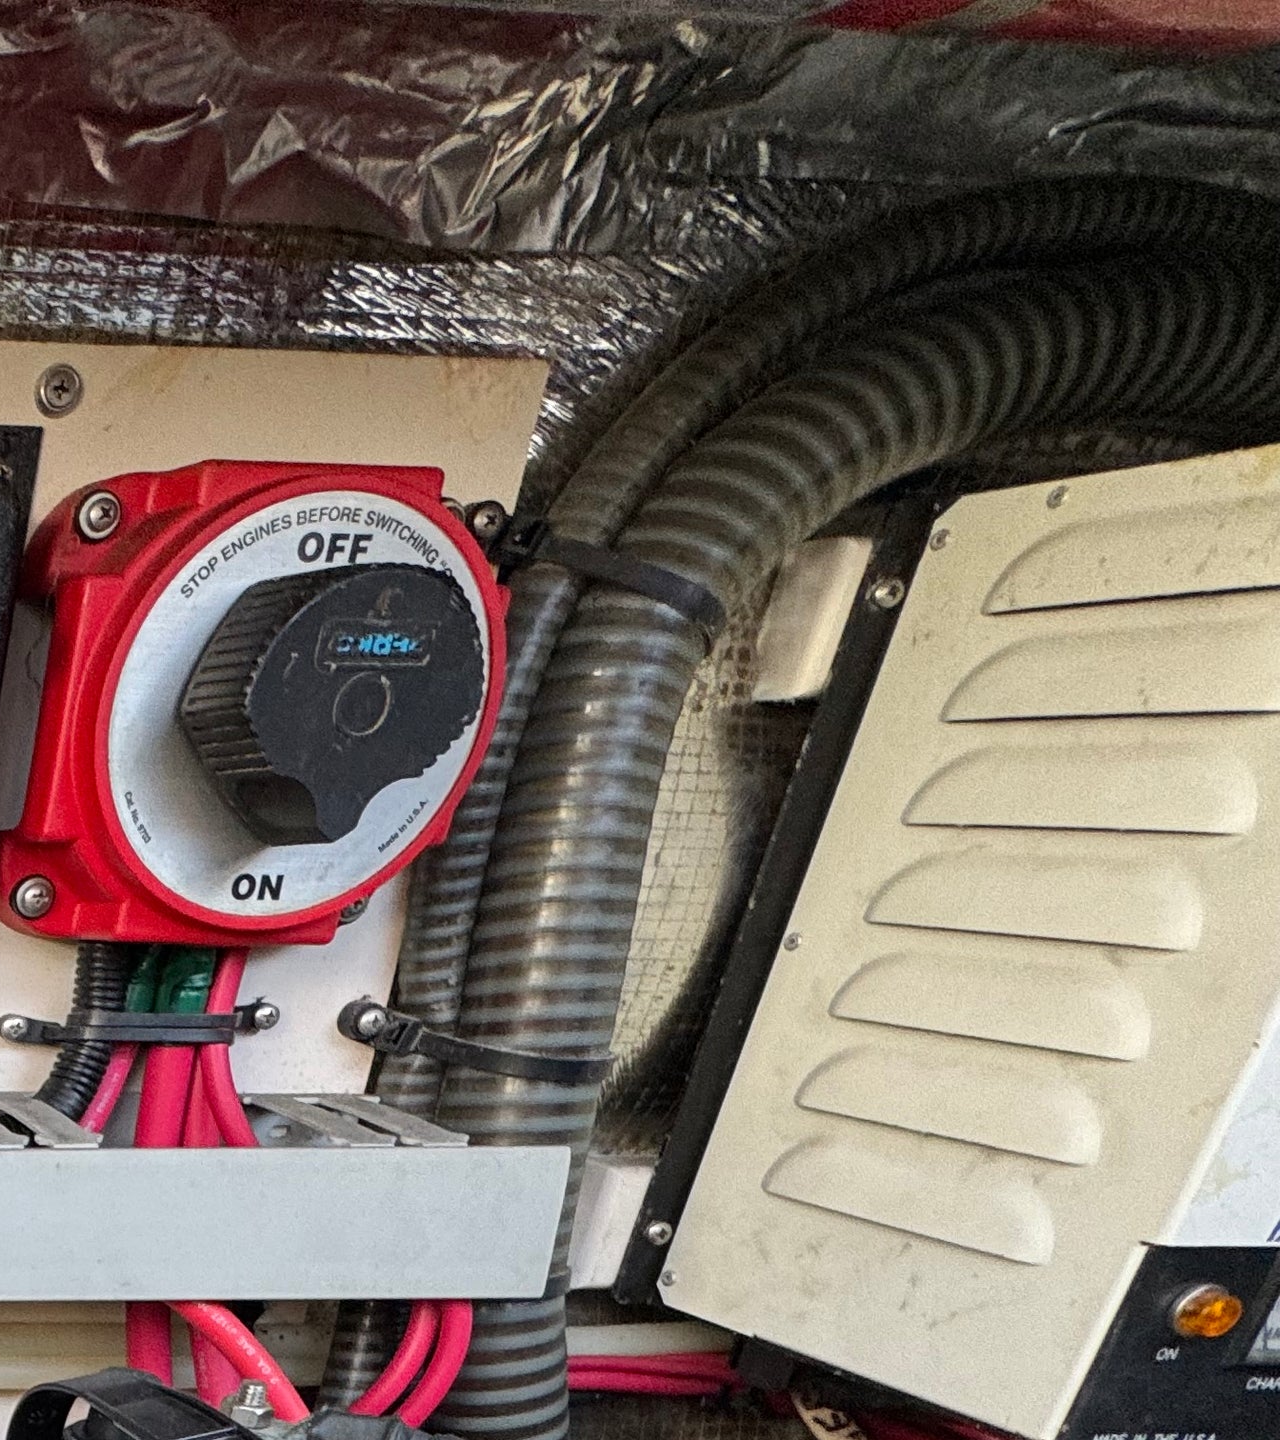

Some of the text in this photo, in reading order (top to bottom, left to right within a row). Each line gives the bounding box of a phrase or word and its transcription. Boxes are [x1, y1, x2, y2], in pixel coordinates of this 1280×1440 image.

[180, 506, 440, 599] STOP ENGINES BEFORE SWITCHING
[297, 531, 374, 564] OFF
[378, 824, 408, 853] Made in
[230, 873, 285, 901] ON
[1155, 1347, 1180, 1361] ON
